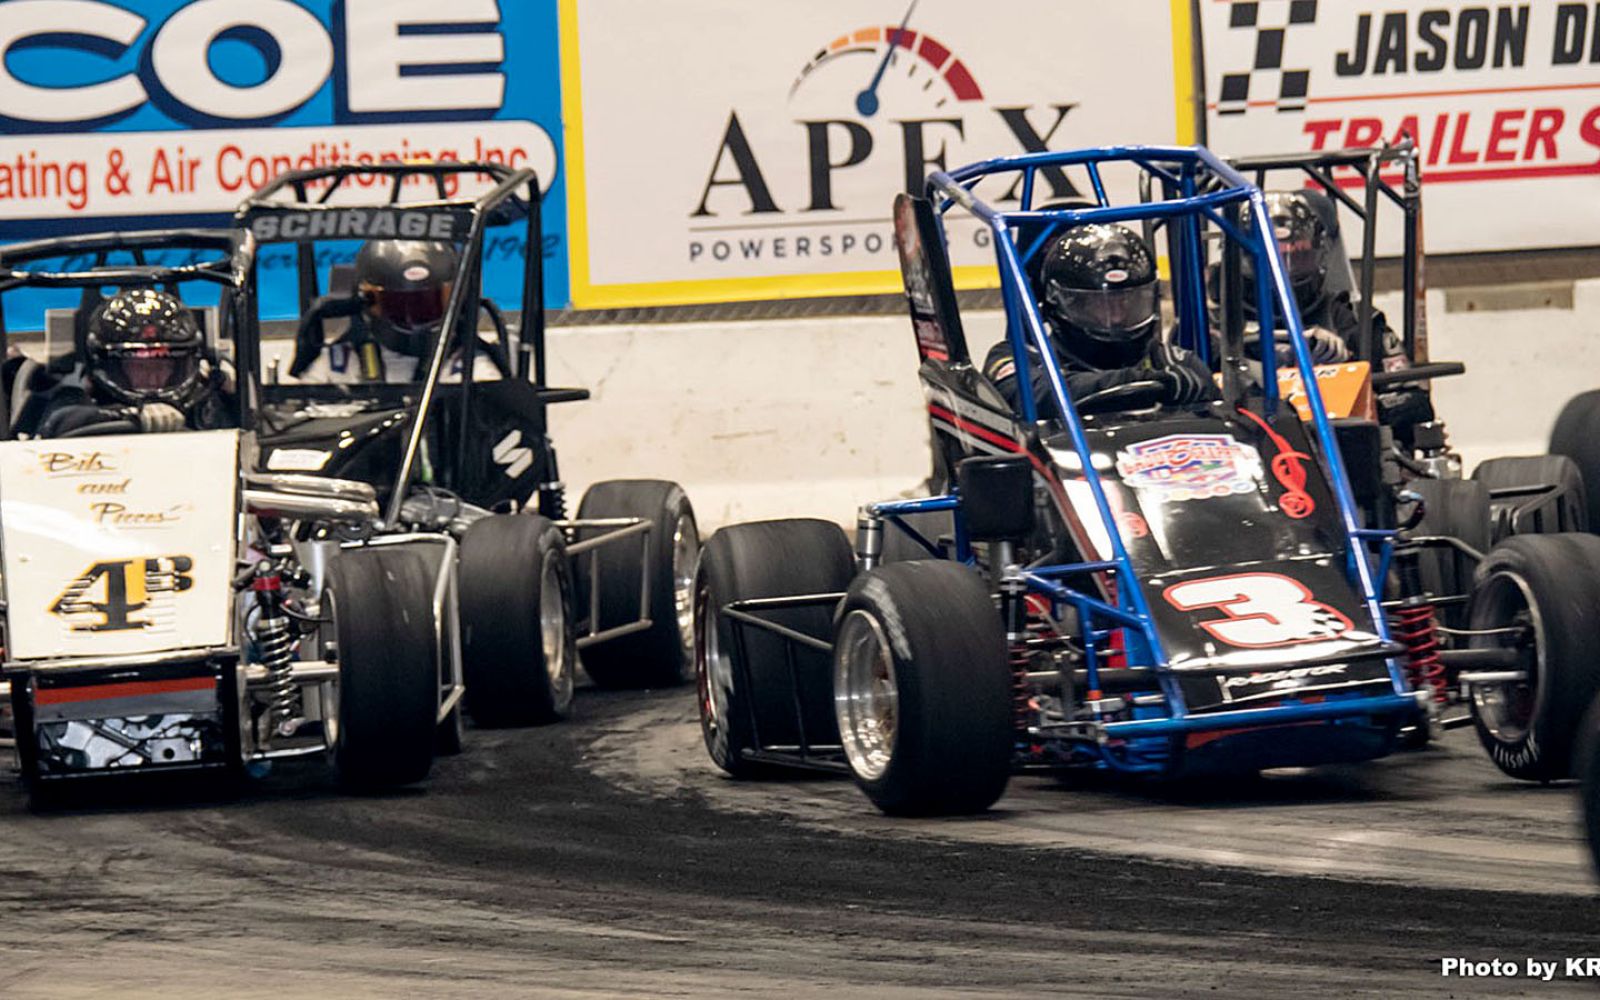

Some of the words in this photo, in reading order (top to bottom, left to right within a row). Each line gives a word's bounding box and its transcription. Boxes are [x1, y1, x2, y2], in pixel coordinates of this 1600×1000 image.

[1335, 6, 1530, 77] JASON
[0, 150, 88, 210] ating
[105, 148, 131, 195] &
[148, 147, 201, 193] Air
[216, 137, 458, 198] Conditioning
[689, 104, 1079, 217] APEX
[1303, 108, 1565, 168] TRAILER
[252, 211, 455, 240] SCHRAGE
[689, 232, 949, 263] POWERSPO
[1163, 572, 1354, 647] 3
